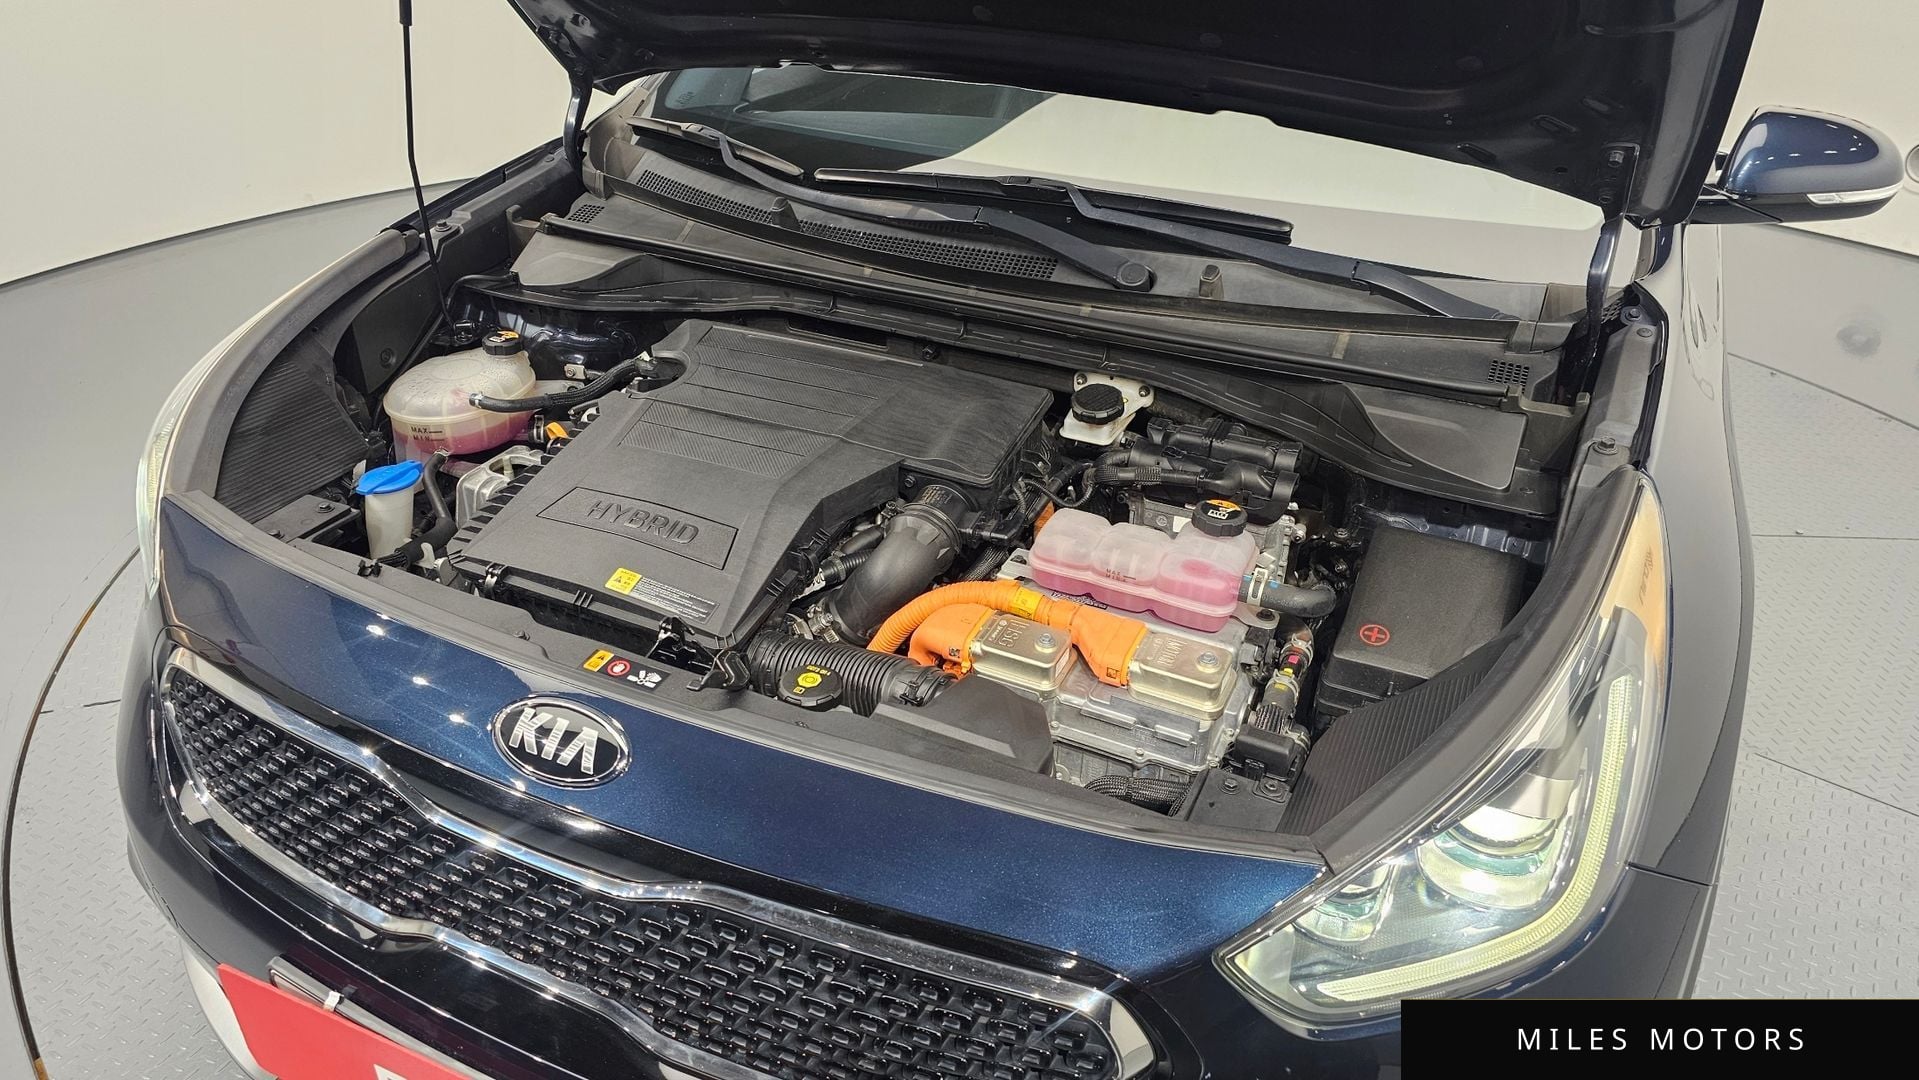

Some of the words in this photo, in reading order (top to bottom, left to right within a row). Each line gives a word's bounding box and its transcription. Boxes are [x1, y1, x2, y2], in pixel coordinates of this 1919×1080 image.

[410, 426, 428, 434] MAX
[586, 500, 699, 544] HYBRID
[508, 706, 599, 775] KIA
